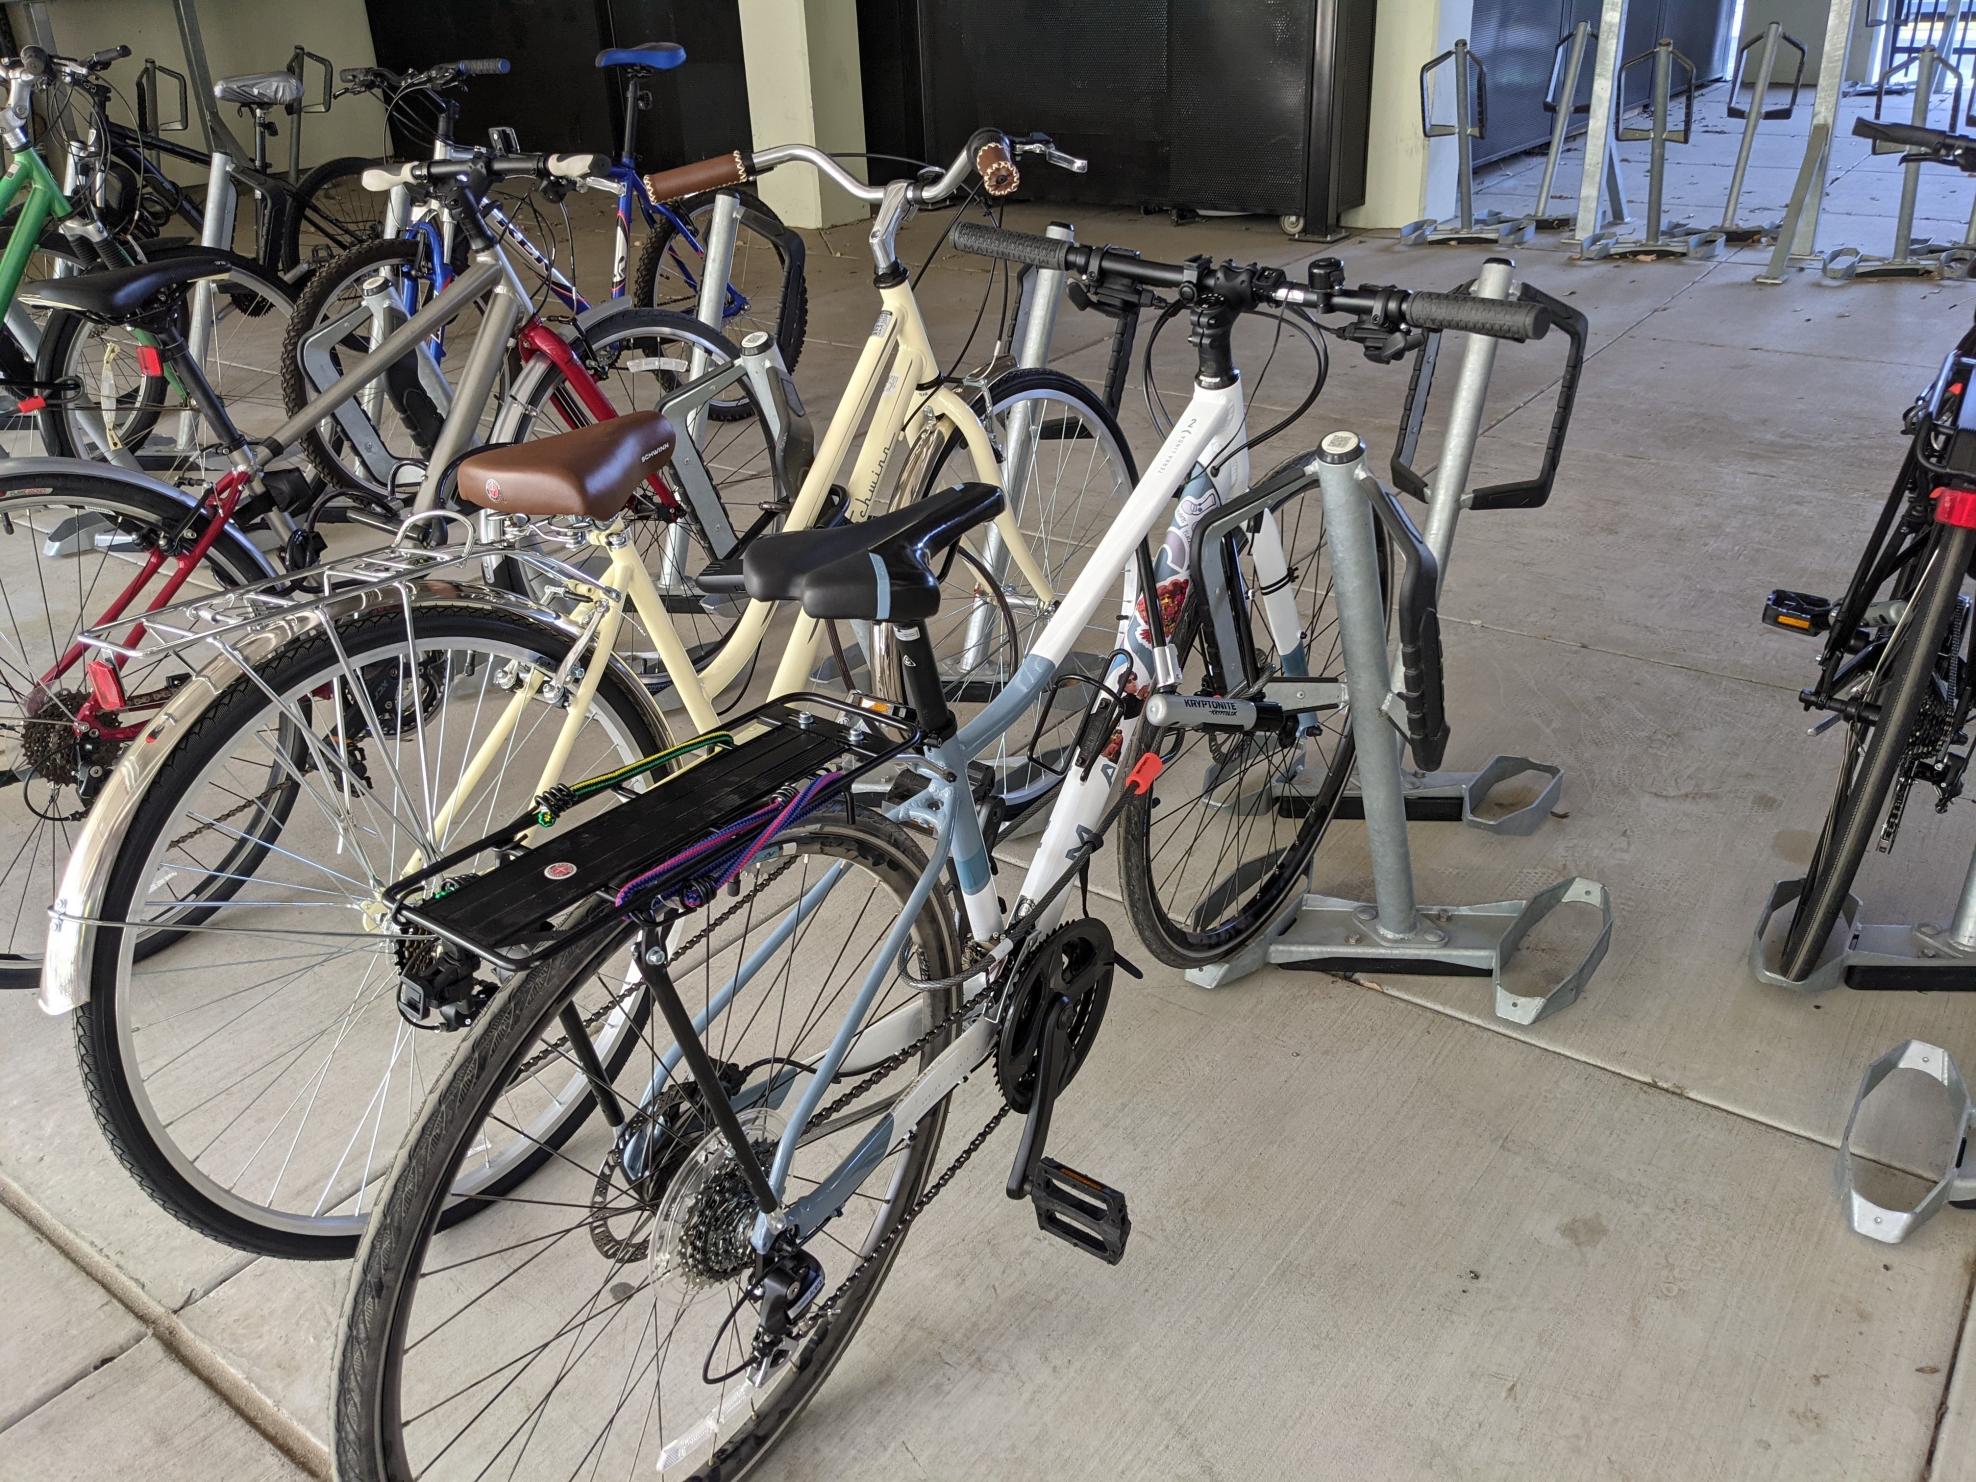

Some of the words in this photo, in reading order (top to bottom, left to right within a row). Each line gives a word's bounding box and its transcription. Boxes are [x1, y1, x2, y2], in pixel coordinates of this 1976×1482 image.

[641, 442, 669, 463] SCHWINN
[850, 432, 896, 519] chwinn
[1184, 699, 1237, 711] KRYPTONITE
